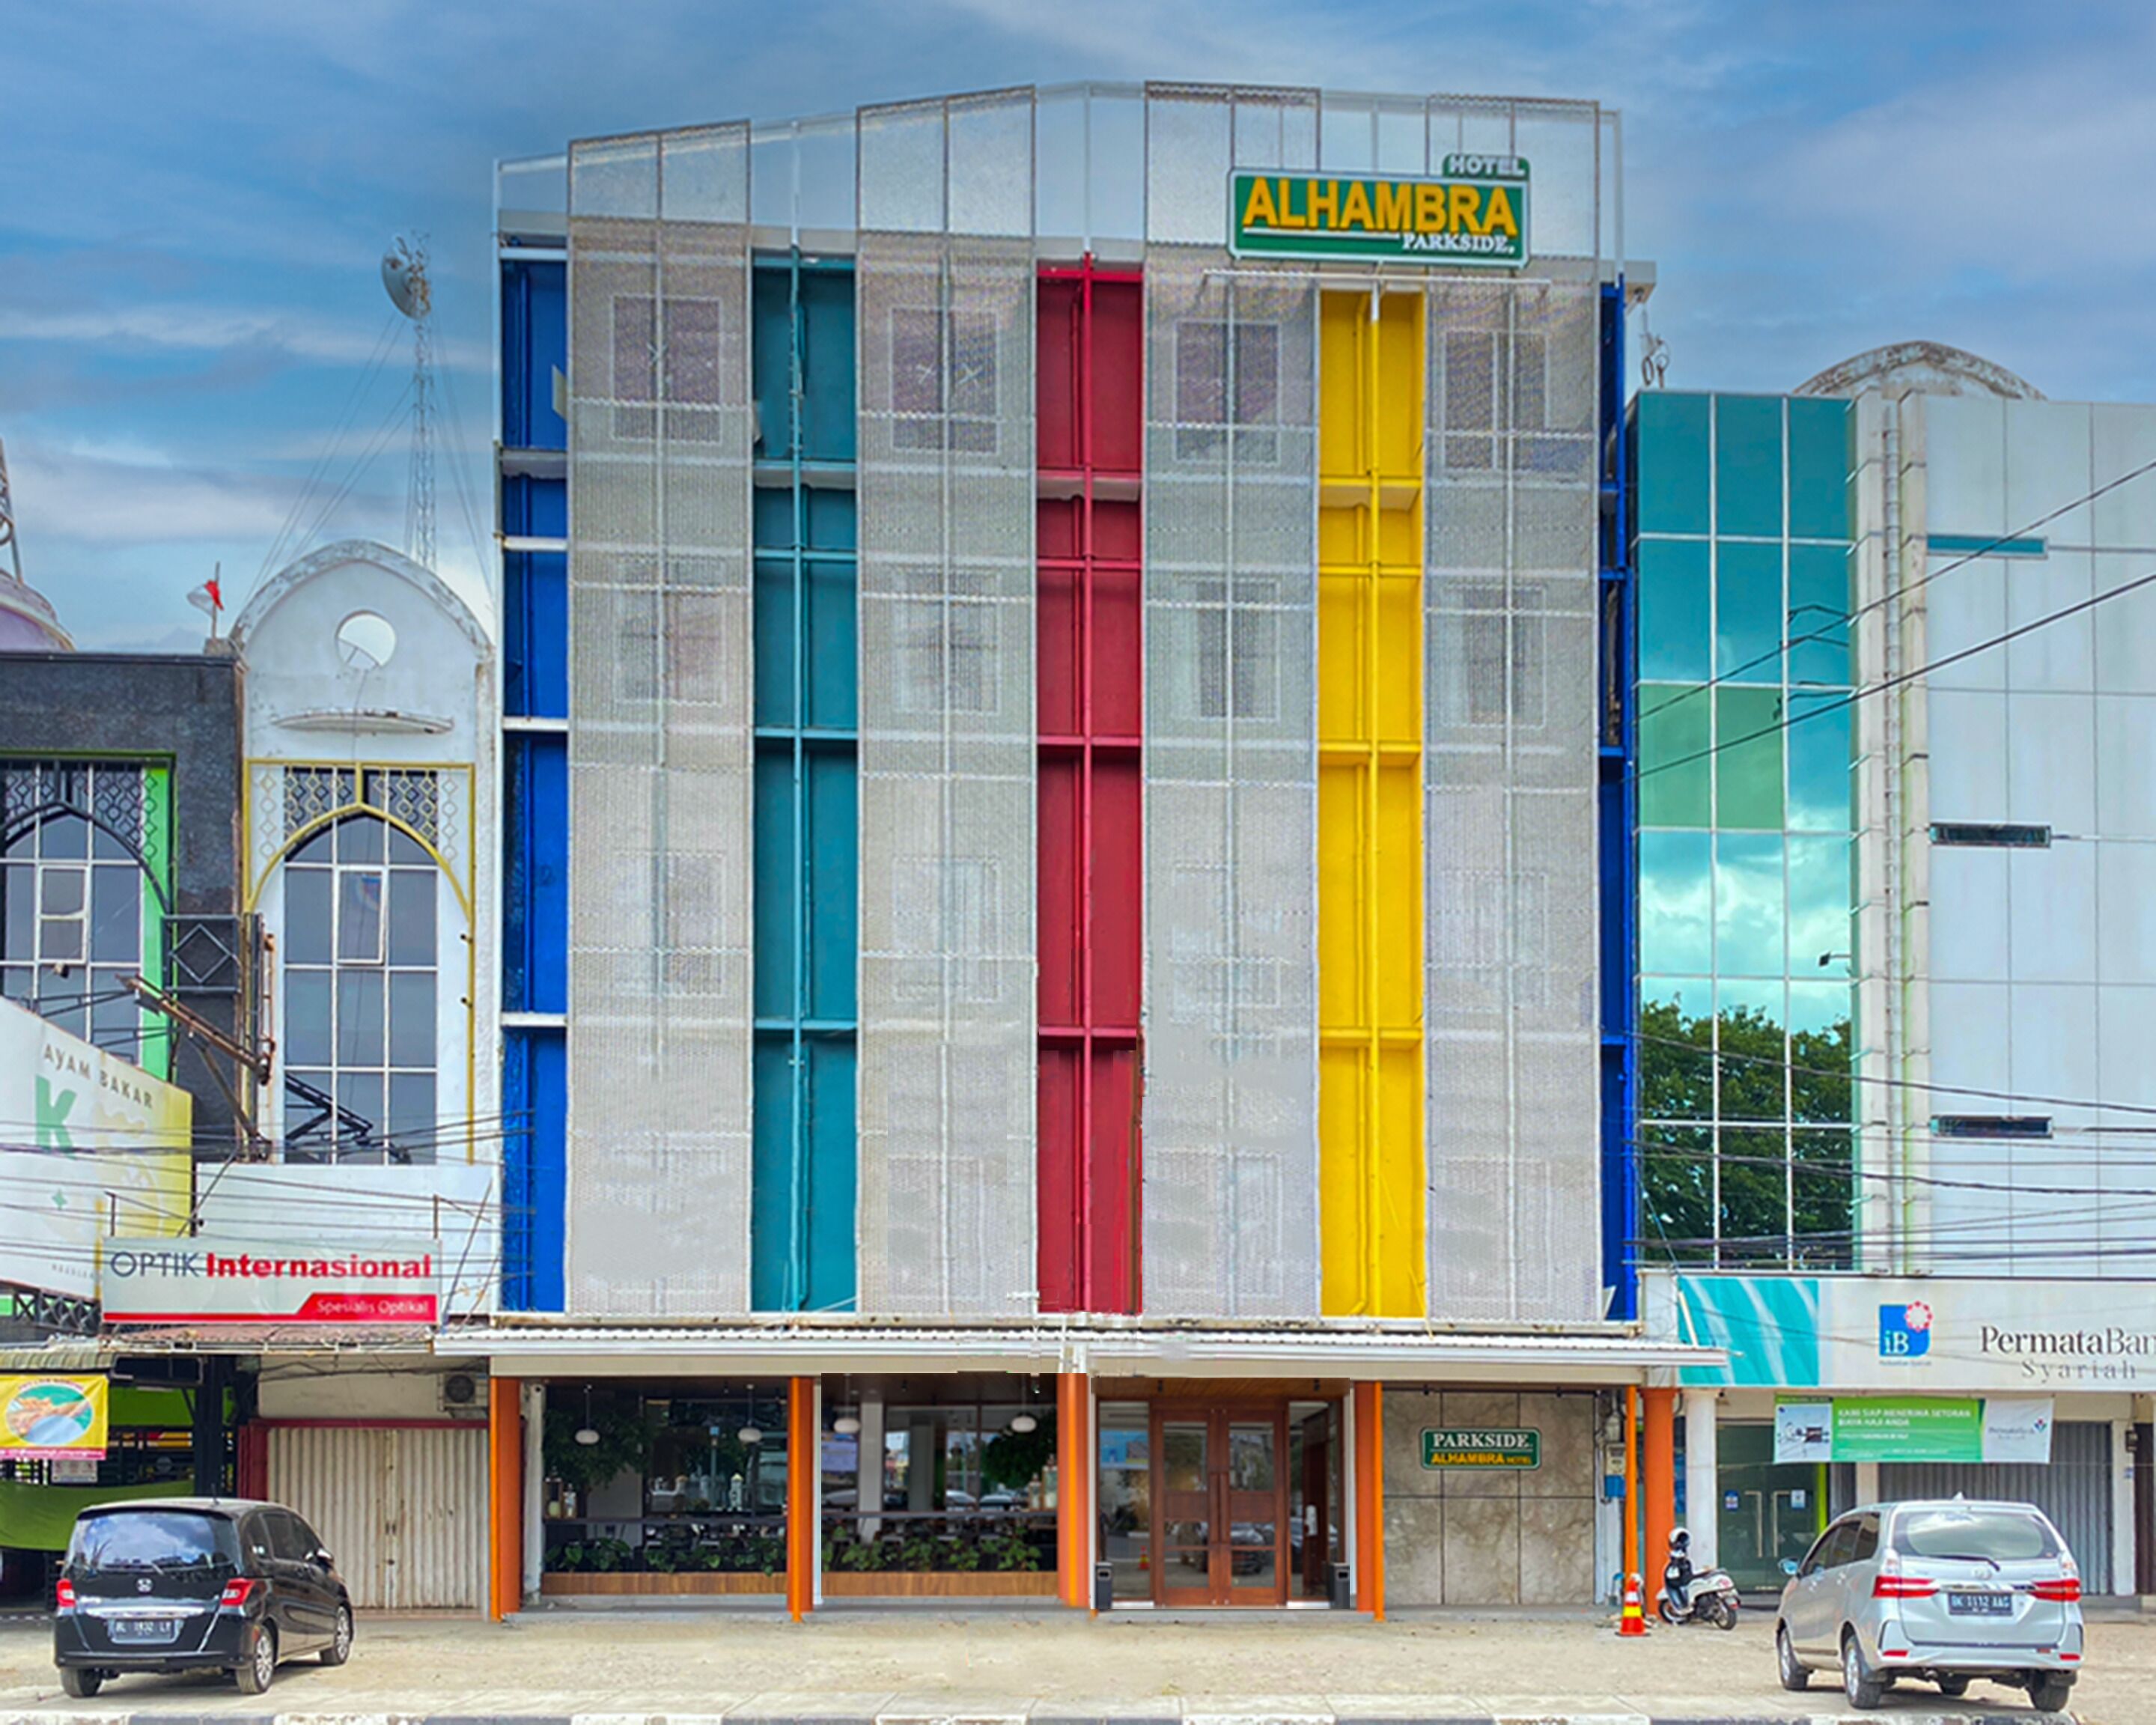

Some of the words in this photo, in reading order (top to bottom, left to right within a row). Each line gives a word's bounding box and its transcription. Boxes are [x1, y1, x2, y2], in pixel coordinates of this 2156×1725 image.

[1449, 156, 1526, 177] HOTEL
[1243, 177, 1518, 237] ALHAMBRA
[99, 1068, 153, 1109] BAKAR
[110, 1251, 201, 1278] OPTIK
[206, 1253, 431, 1279] Internasional
[317, 1300, 374, 1315] Spesialis
[377, 1300, 428, 1315] Optikal
[1884, 1330, 1910, 1354] iB
[2021, 1358, 2136, 1383] Syariah
[1862, 1409, 1881, 1417] SIAP
[1883, 1409, 1929, 1418] MENERIMA
[1884, 1418, 1910, 1426] ANDA
[1431, 1452, 1505, 1464] ALHAMBRA
